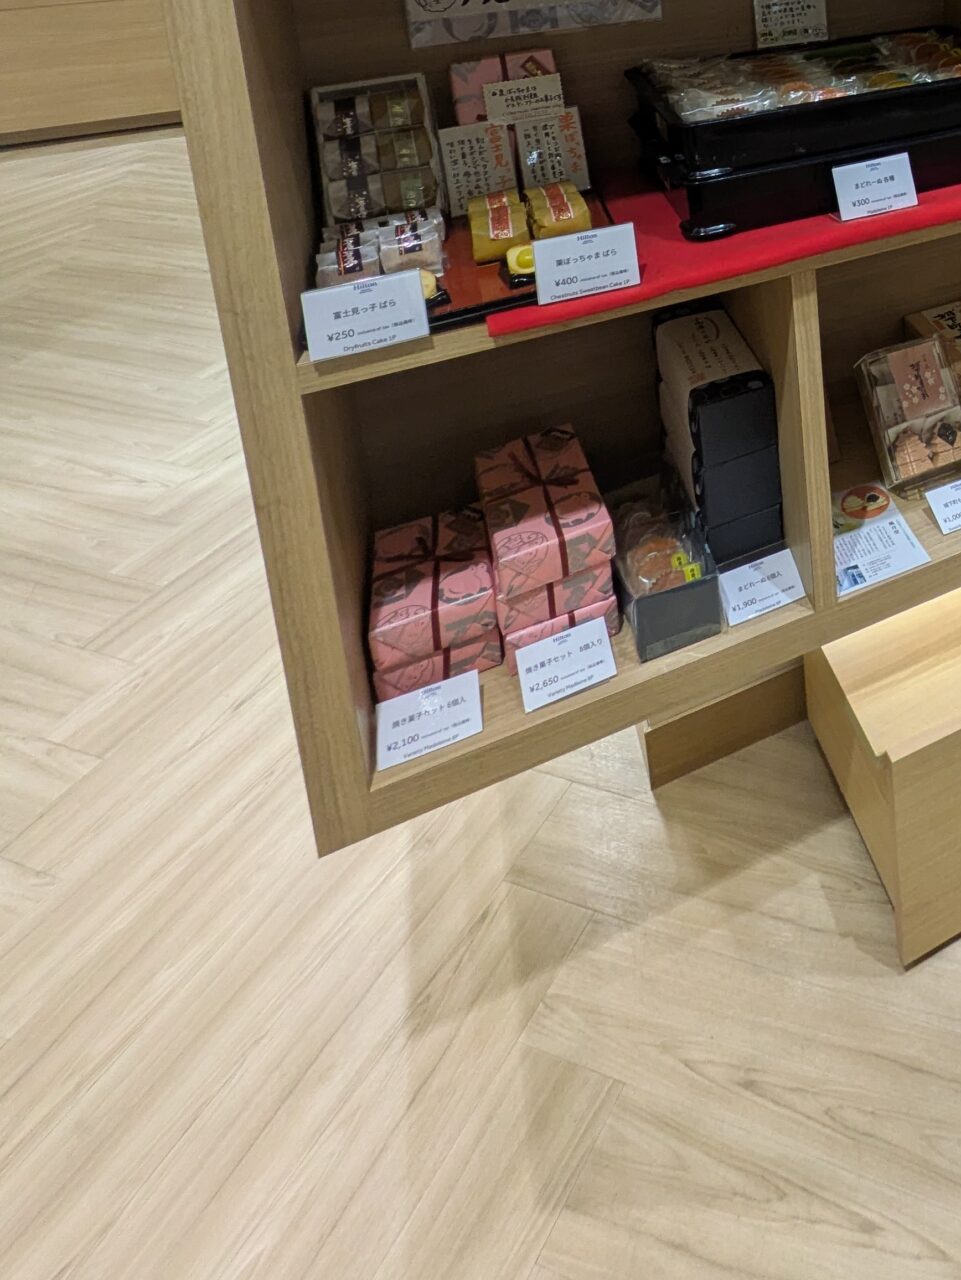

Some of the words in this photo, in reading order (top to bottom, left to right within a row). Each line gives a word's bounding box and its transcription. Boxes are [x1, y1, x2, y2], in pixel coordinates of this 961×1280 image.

[852, 198, 870, 207] ¥300
[554, 275, 578, 287] ¥400
[333, 302, 377, 320] 富士見っ子
[379, 299, 397, 310] ばら
[327, 328, 355, 342] ¥250
[732, 597, 757, 612] ¥1,900
[529, 675, 559, 693] ¥2,650
[387, 733, 419, 752] ¥2,100
